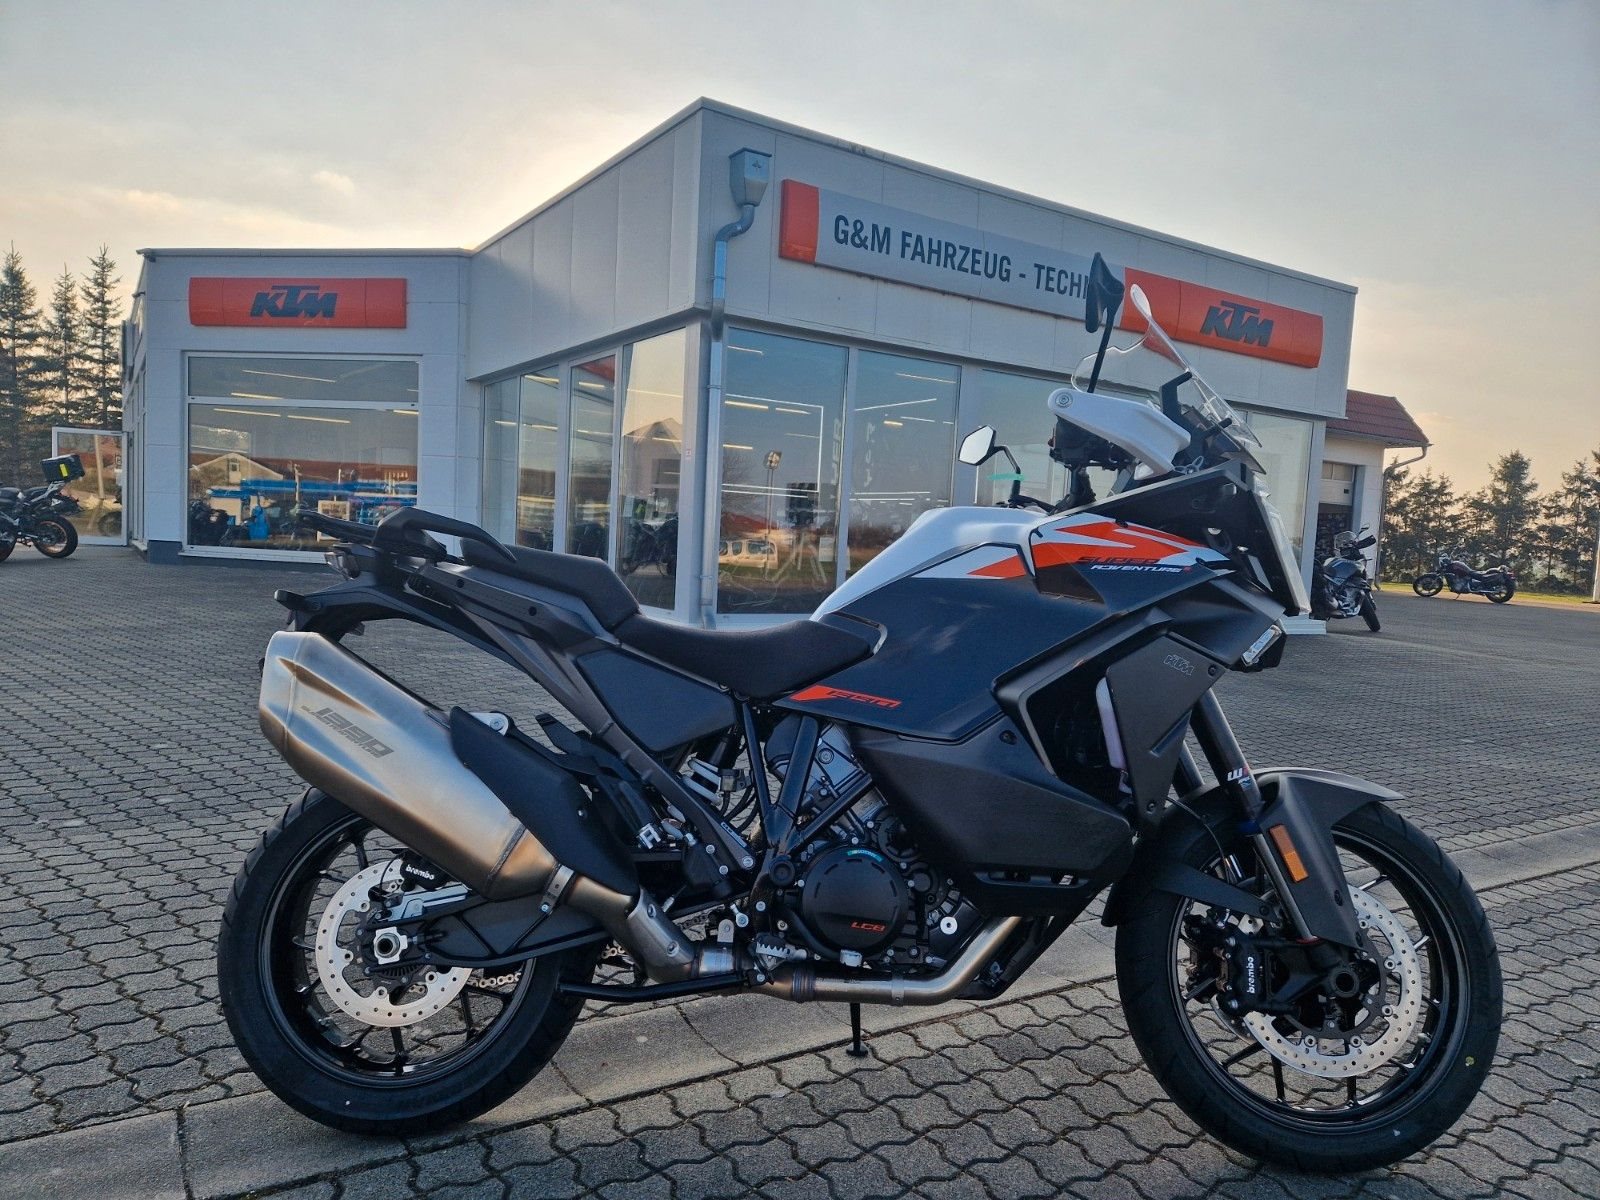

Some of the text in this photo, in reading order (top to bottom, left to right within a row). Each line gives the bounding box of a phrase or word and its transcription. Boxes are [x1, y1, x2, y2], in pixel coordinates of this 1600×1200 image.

[834, 215, 890, 255] G&M
[901, 231, 1011, 282] FAHRZEUG
[250, 286, 338, 318] KTM
[1200, 300, 1274, 347] KTM
[1091, 564, 1183, 573] ADVENTURE
[1163, 654, 1194, 676] KTM
[406, 864, 435, 880] brembo
[851, 921, 886, 931] LC8
[1246, 956, 1255, 994] brembo
